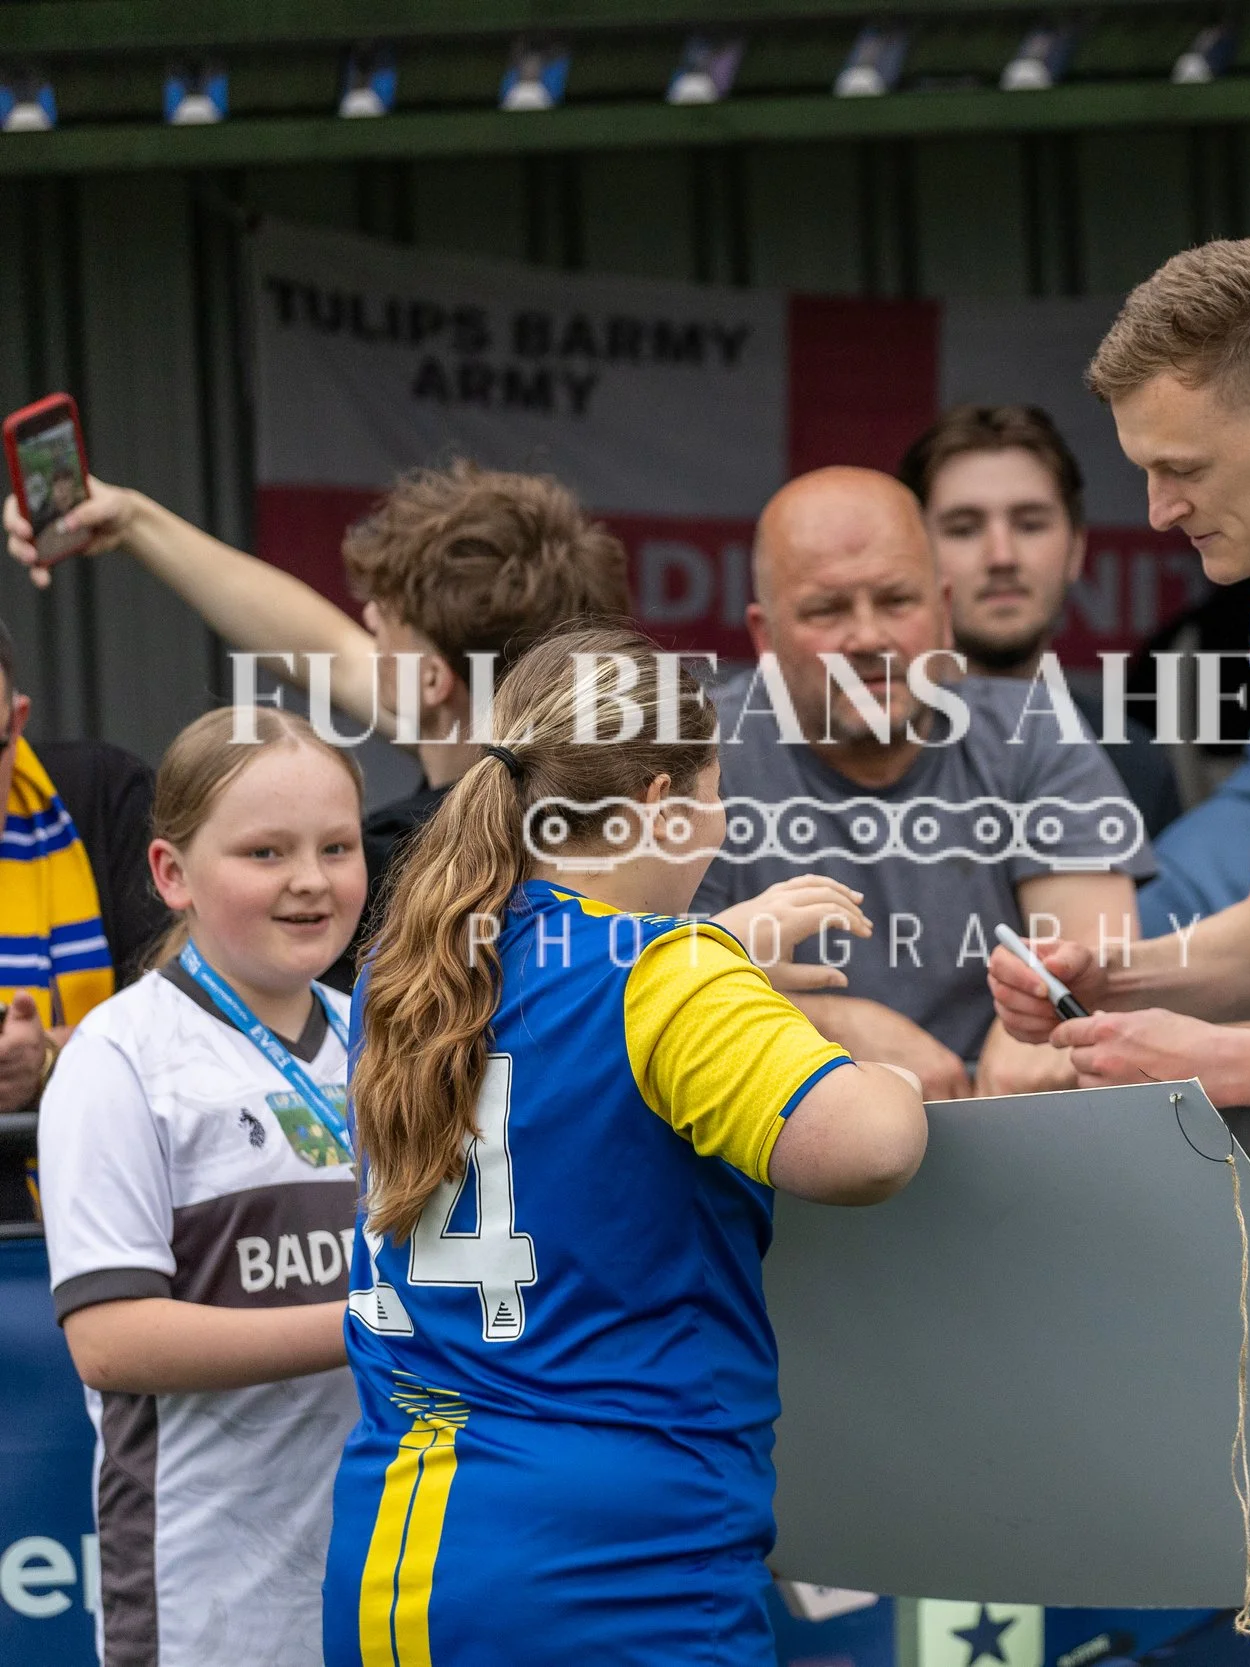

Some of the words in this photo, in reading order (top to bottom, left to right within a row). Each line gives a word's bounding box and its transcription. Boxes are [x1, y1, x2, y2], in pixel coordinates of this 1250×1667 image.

[264, 276, 491, 355] TULIPS
[513, 309, 751, 367] BARMY
[412, 357, 600, 415] ARMY
